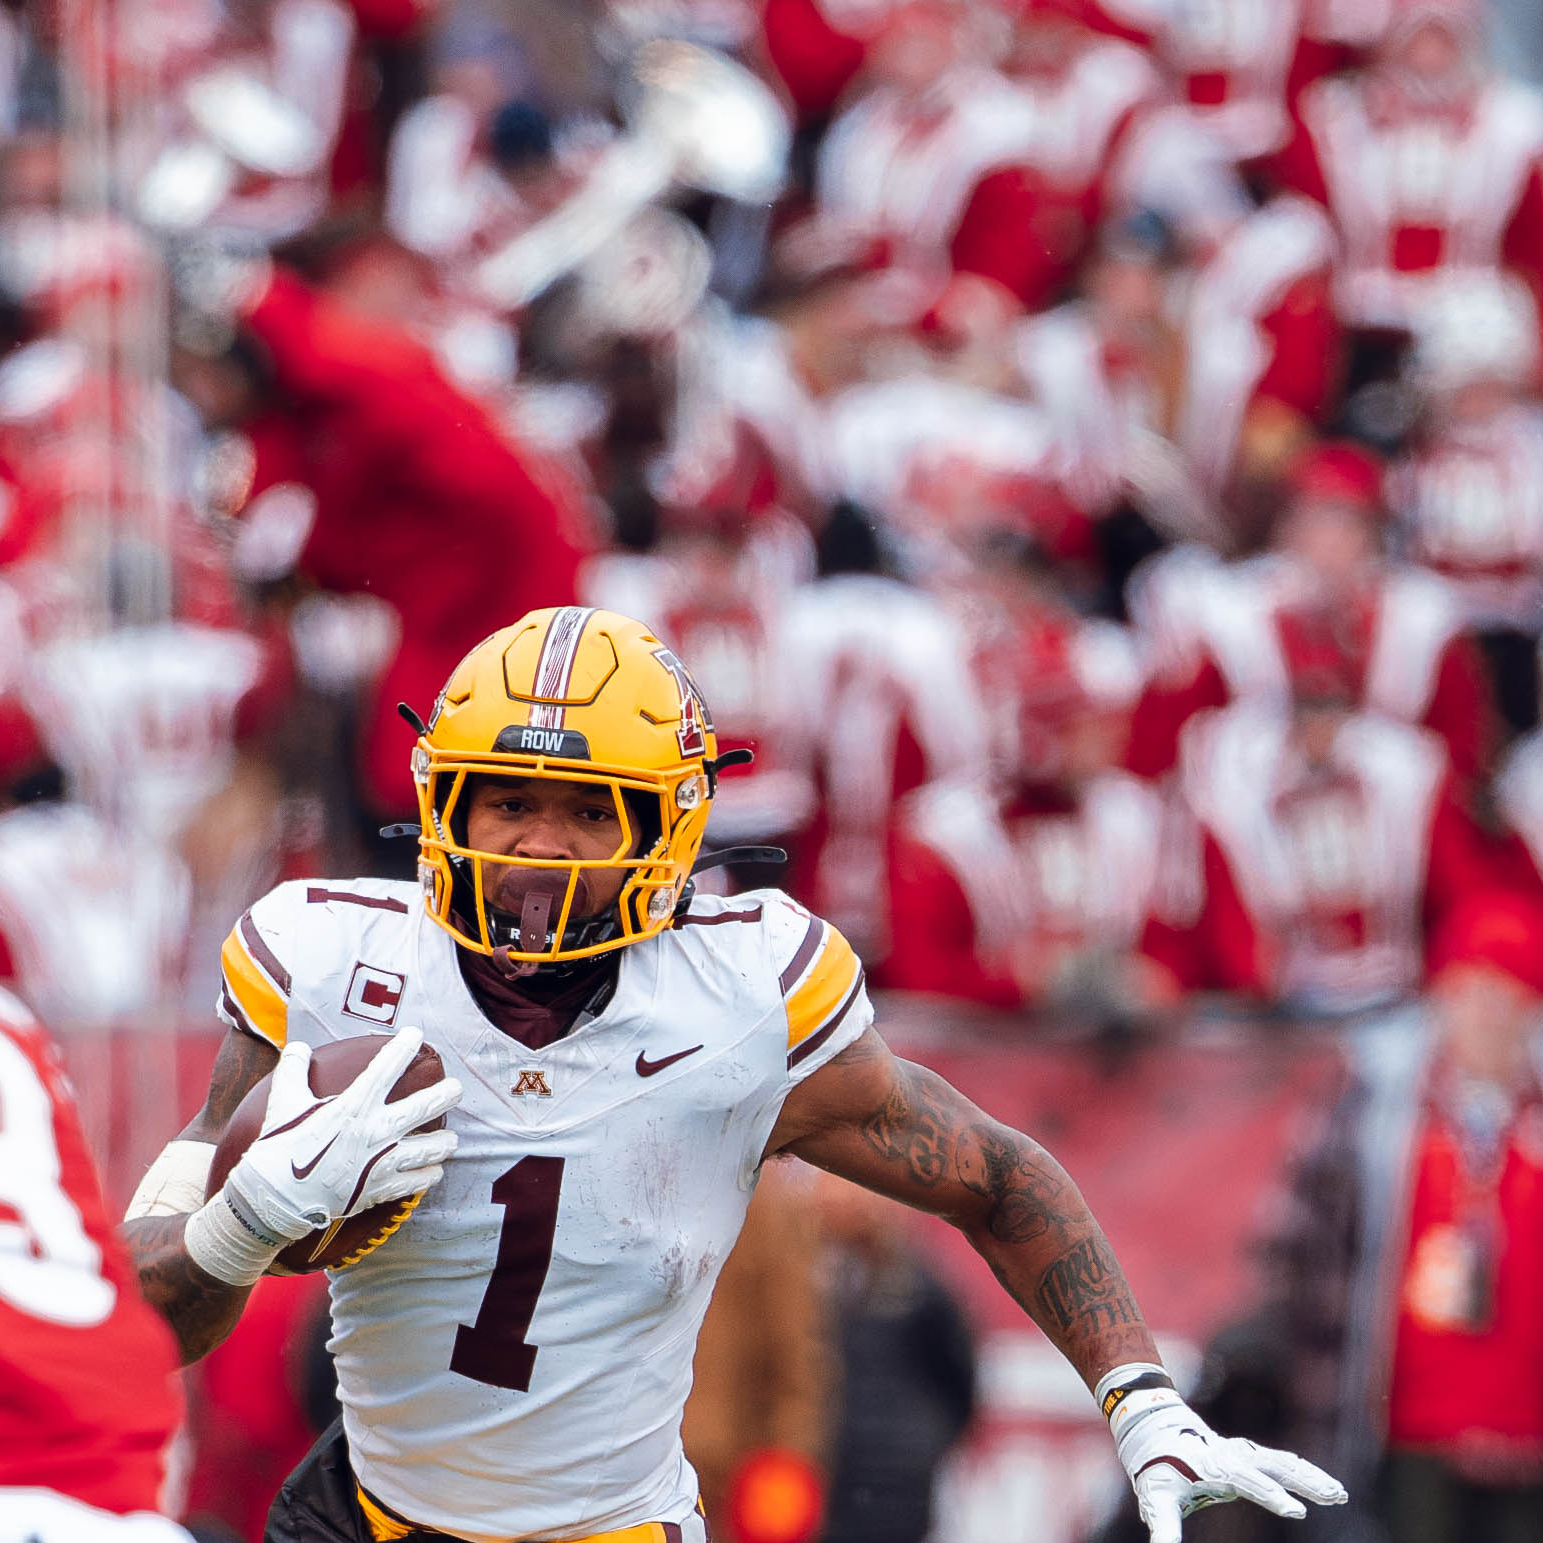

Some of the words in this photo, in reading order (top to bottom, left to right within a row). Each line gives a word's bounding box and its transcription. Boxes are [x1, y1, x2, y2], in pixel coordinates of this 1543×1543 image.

[520, 729, 565, 752] ROW
[343, 961, 406, 1026] C
[510, 1070, 553, 1098] M
[448, 1153, 566, 1393] 1
